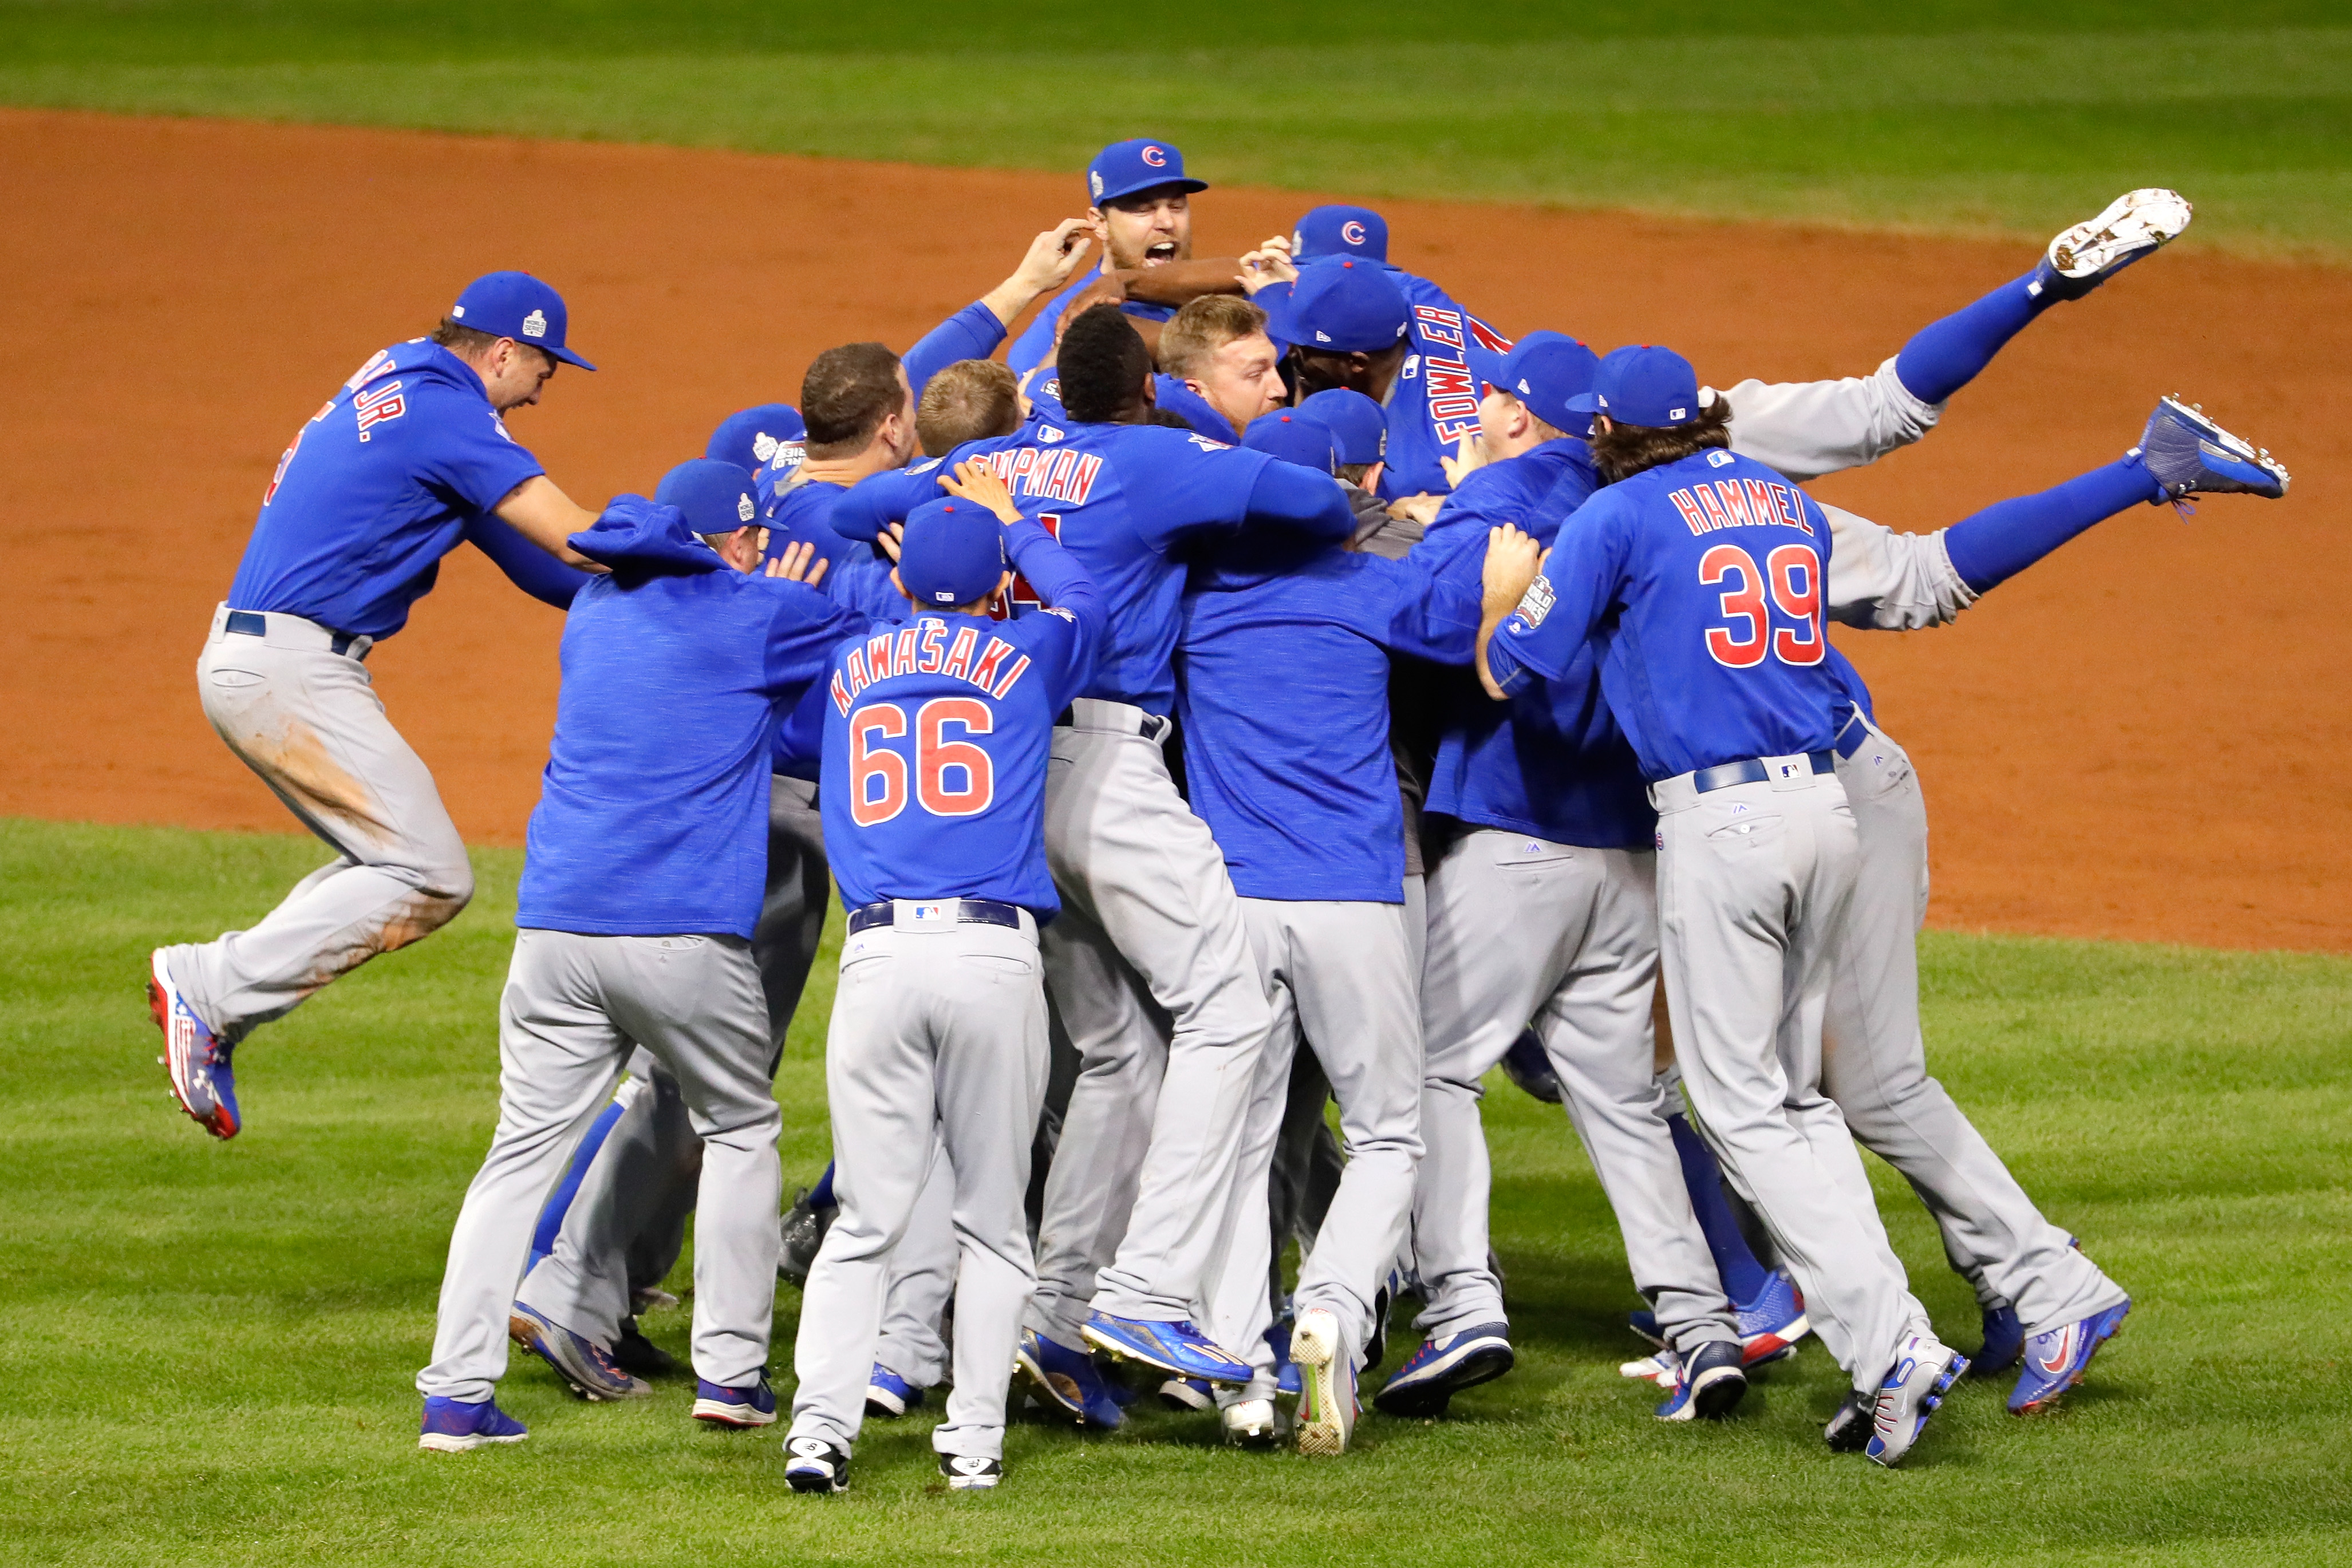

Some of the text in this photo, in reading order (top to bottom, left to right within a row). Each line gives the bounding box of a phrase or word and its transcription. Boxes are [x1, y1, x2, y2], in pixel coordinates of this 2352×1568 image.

[1141, 145, 1166, 167] C
[1341, 220, 1367, 246] C
[524, 325, 544, 333] SERIES
[1414, 305, 1483, 445] FOWLER
[353, 380, 406, 443] JR.
[1668, 479, 1814, 537] HAMMEL
[1698, 544, 1825, 669] 39
[830, 626, 1031, 718] KAWASAKI
[849, 697, 994, 827] 66
